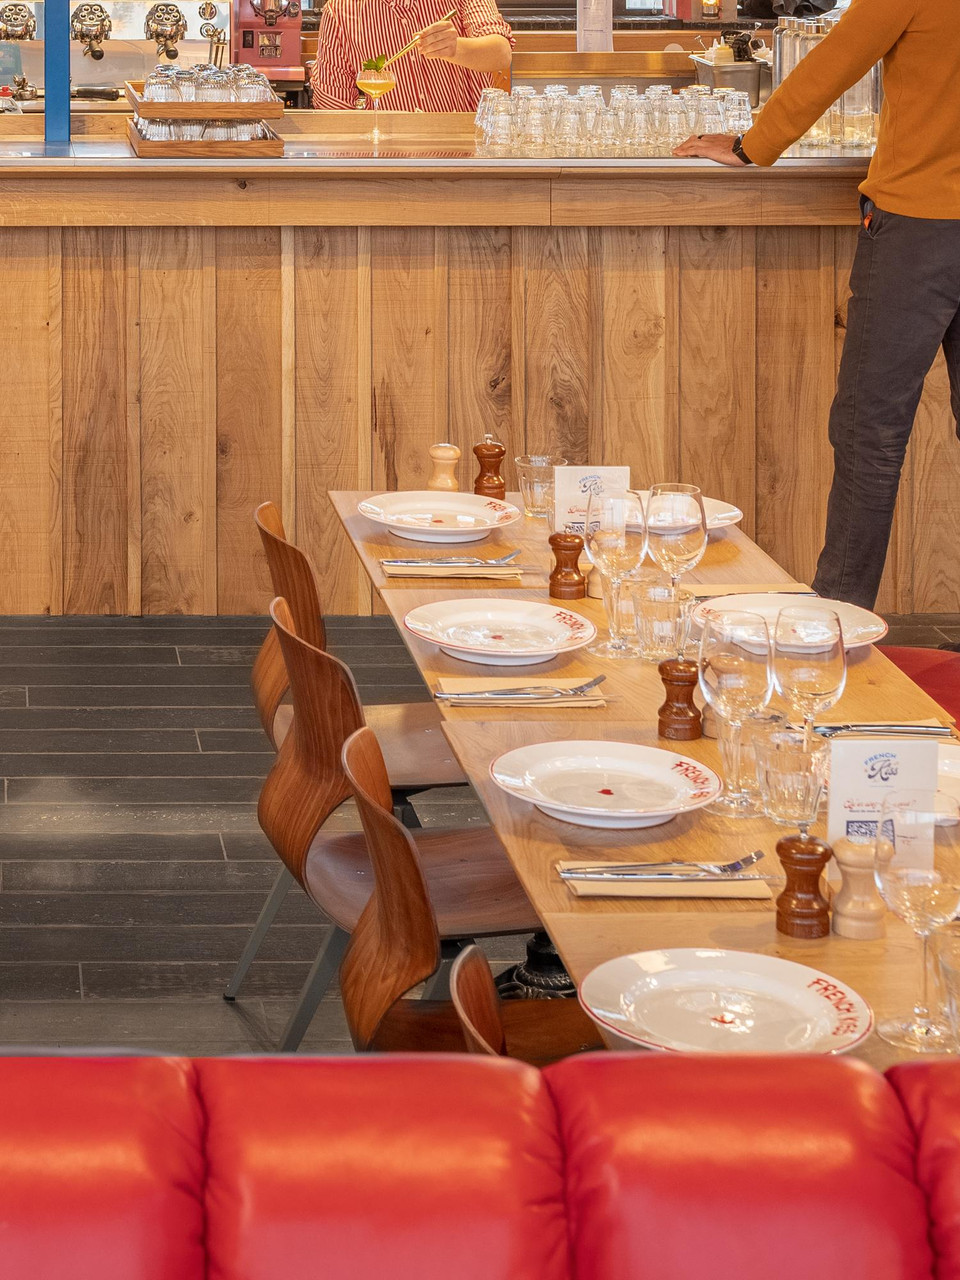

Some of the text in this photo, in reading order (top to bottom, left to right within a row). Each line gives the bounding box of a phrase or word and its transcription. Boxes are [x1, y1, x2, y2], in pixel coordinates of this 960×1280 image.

[864, 752, 897, 766] FRENCH
[868, 759, 898, 782] Kiss
[671, 761, 712, 787] FRENCH
[807, 977, 857, 1015] FRENCH
